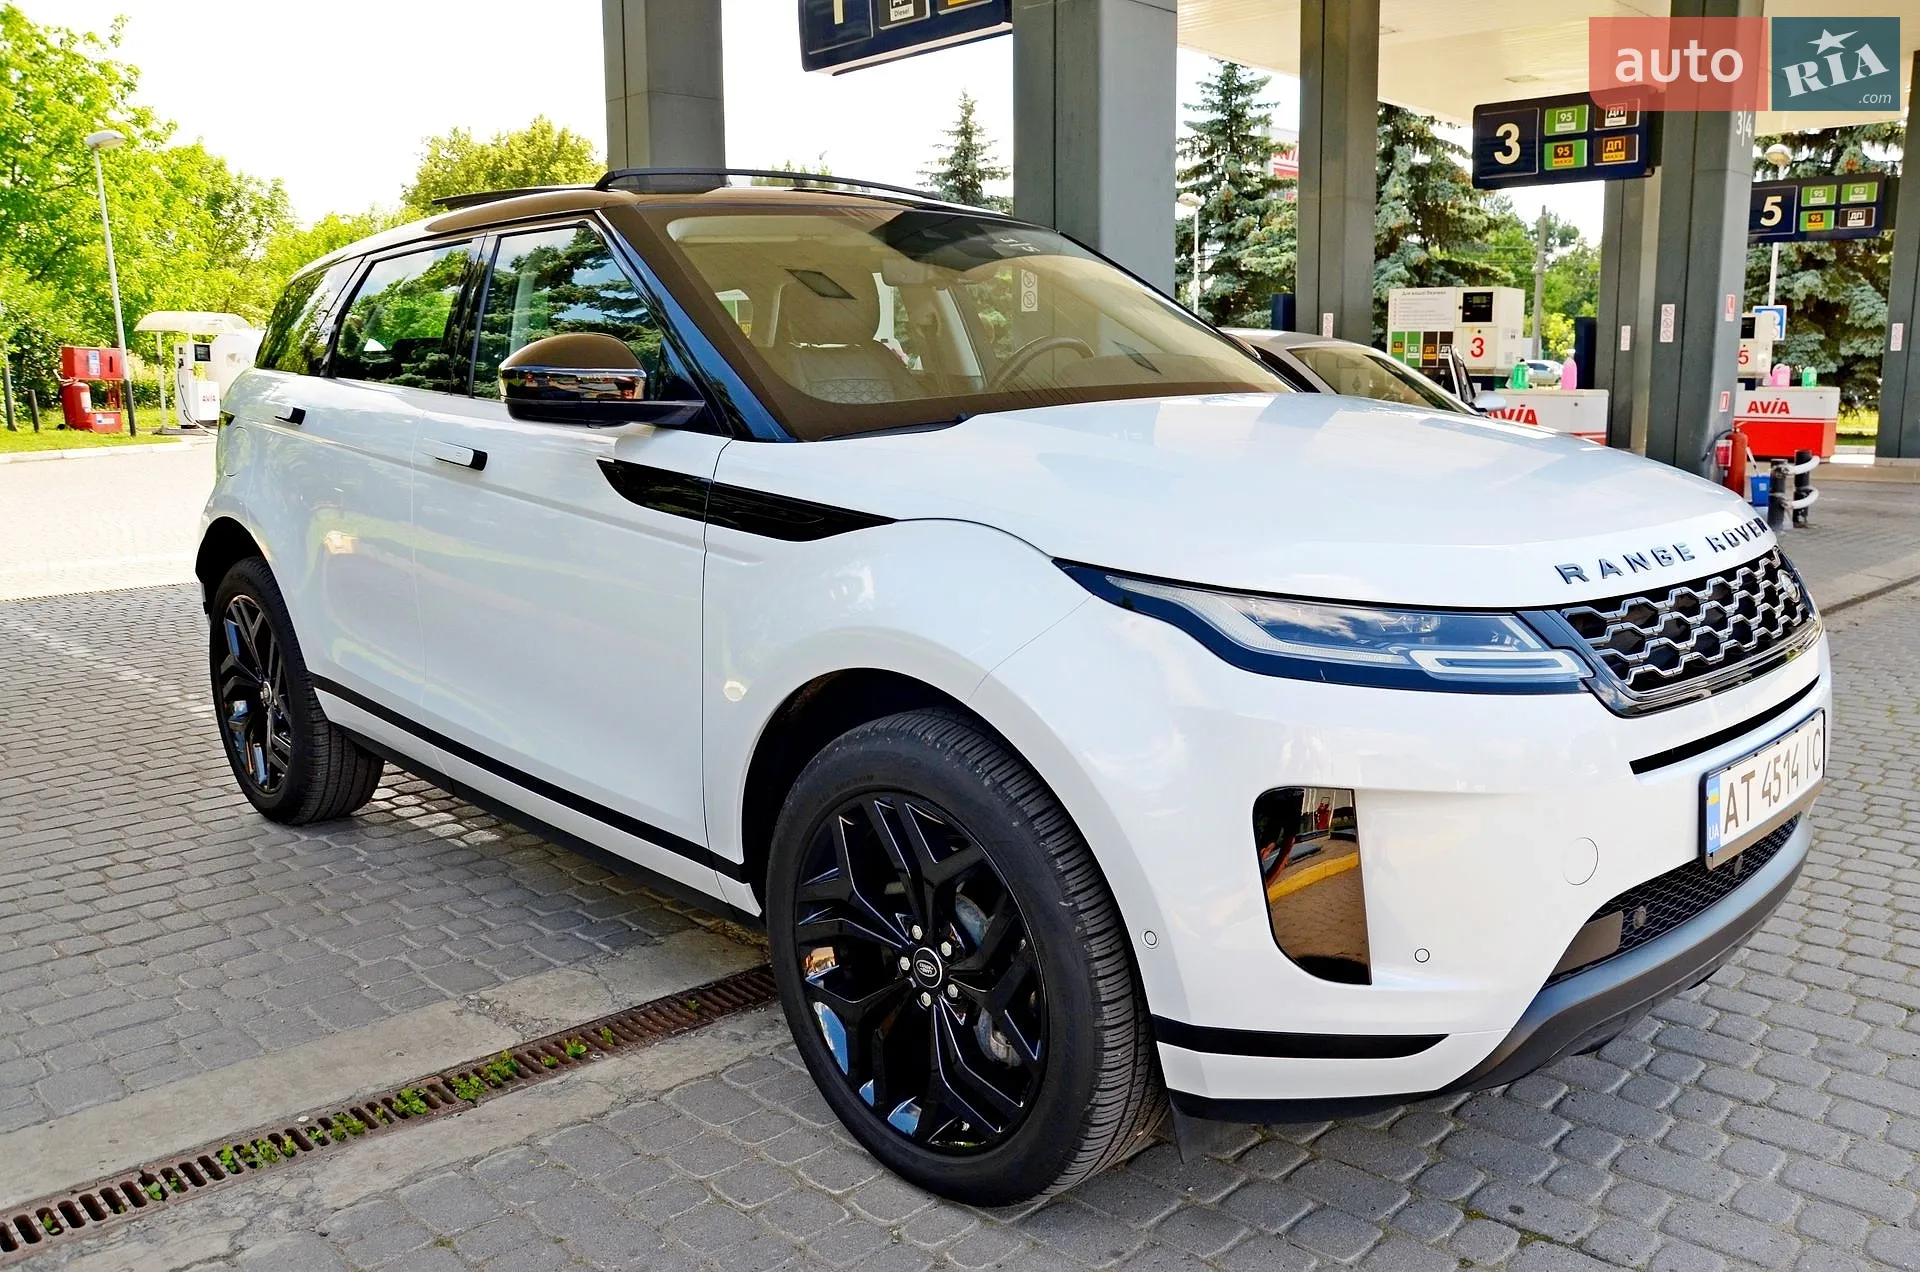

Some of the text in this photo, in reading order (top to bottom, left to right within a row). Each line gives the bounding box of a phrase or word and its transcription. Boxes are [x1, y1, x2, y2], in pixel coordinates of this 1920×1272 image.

[1560, 112, 1573, 122] 95
[1608, 106, 1624, 118] ДП
[1494, 123, 1521, 165] 3
[1557, 146, 1570, 156] 95
[1606, 140, 1622, 153] ДП
[1813, 189, 1824, 197] 95
[1760, 196, 1782, 227] 5
[1810, 214, 1821, 222] 95
[1470, 337, 1485, 358] 3
[1738, 349, 1749, 365] 5
[1554, 517, 1768, 585] RANGE ROVER
[1724, 728, 1822, 834] AT 4514 IC
[1708, 825, 1720, 840] UA
